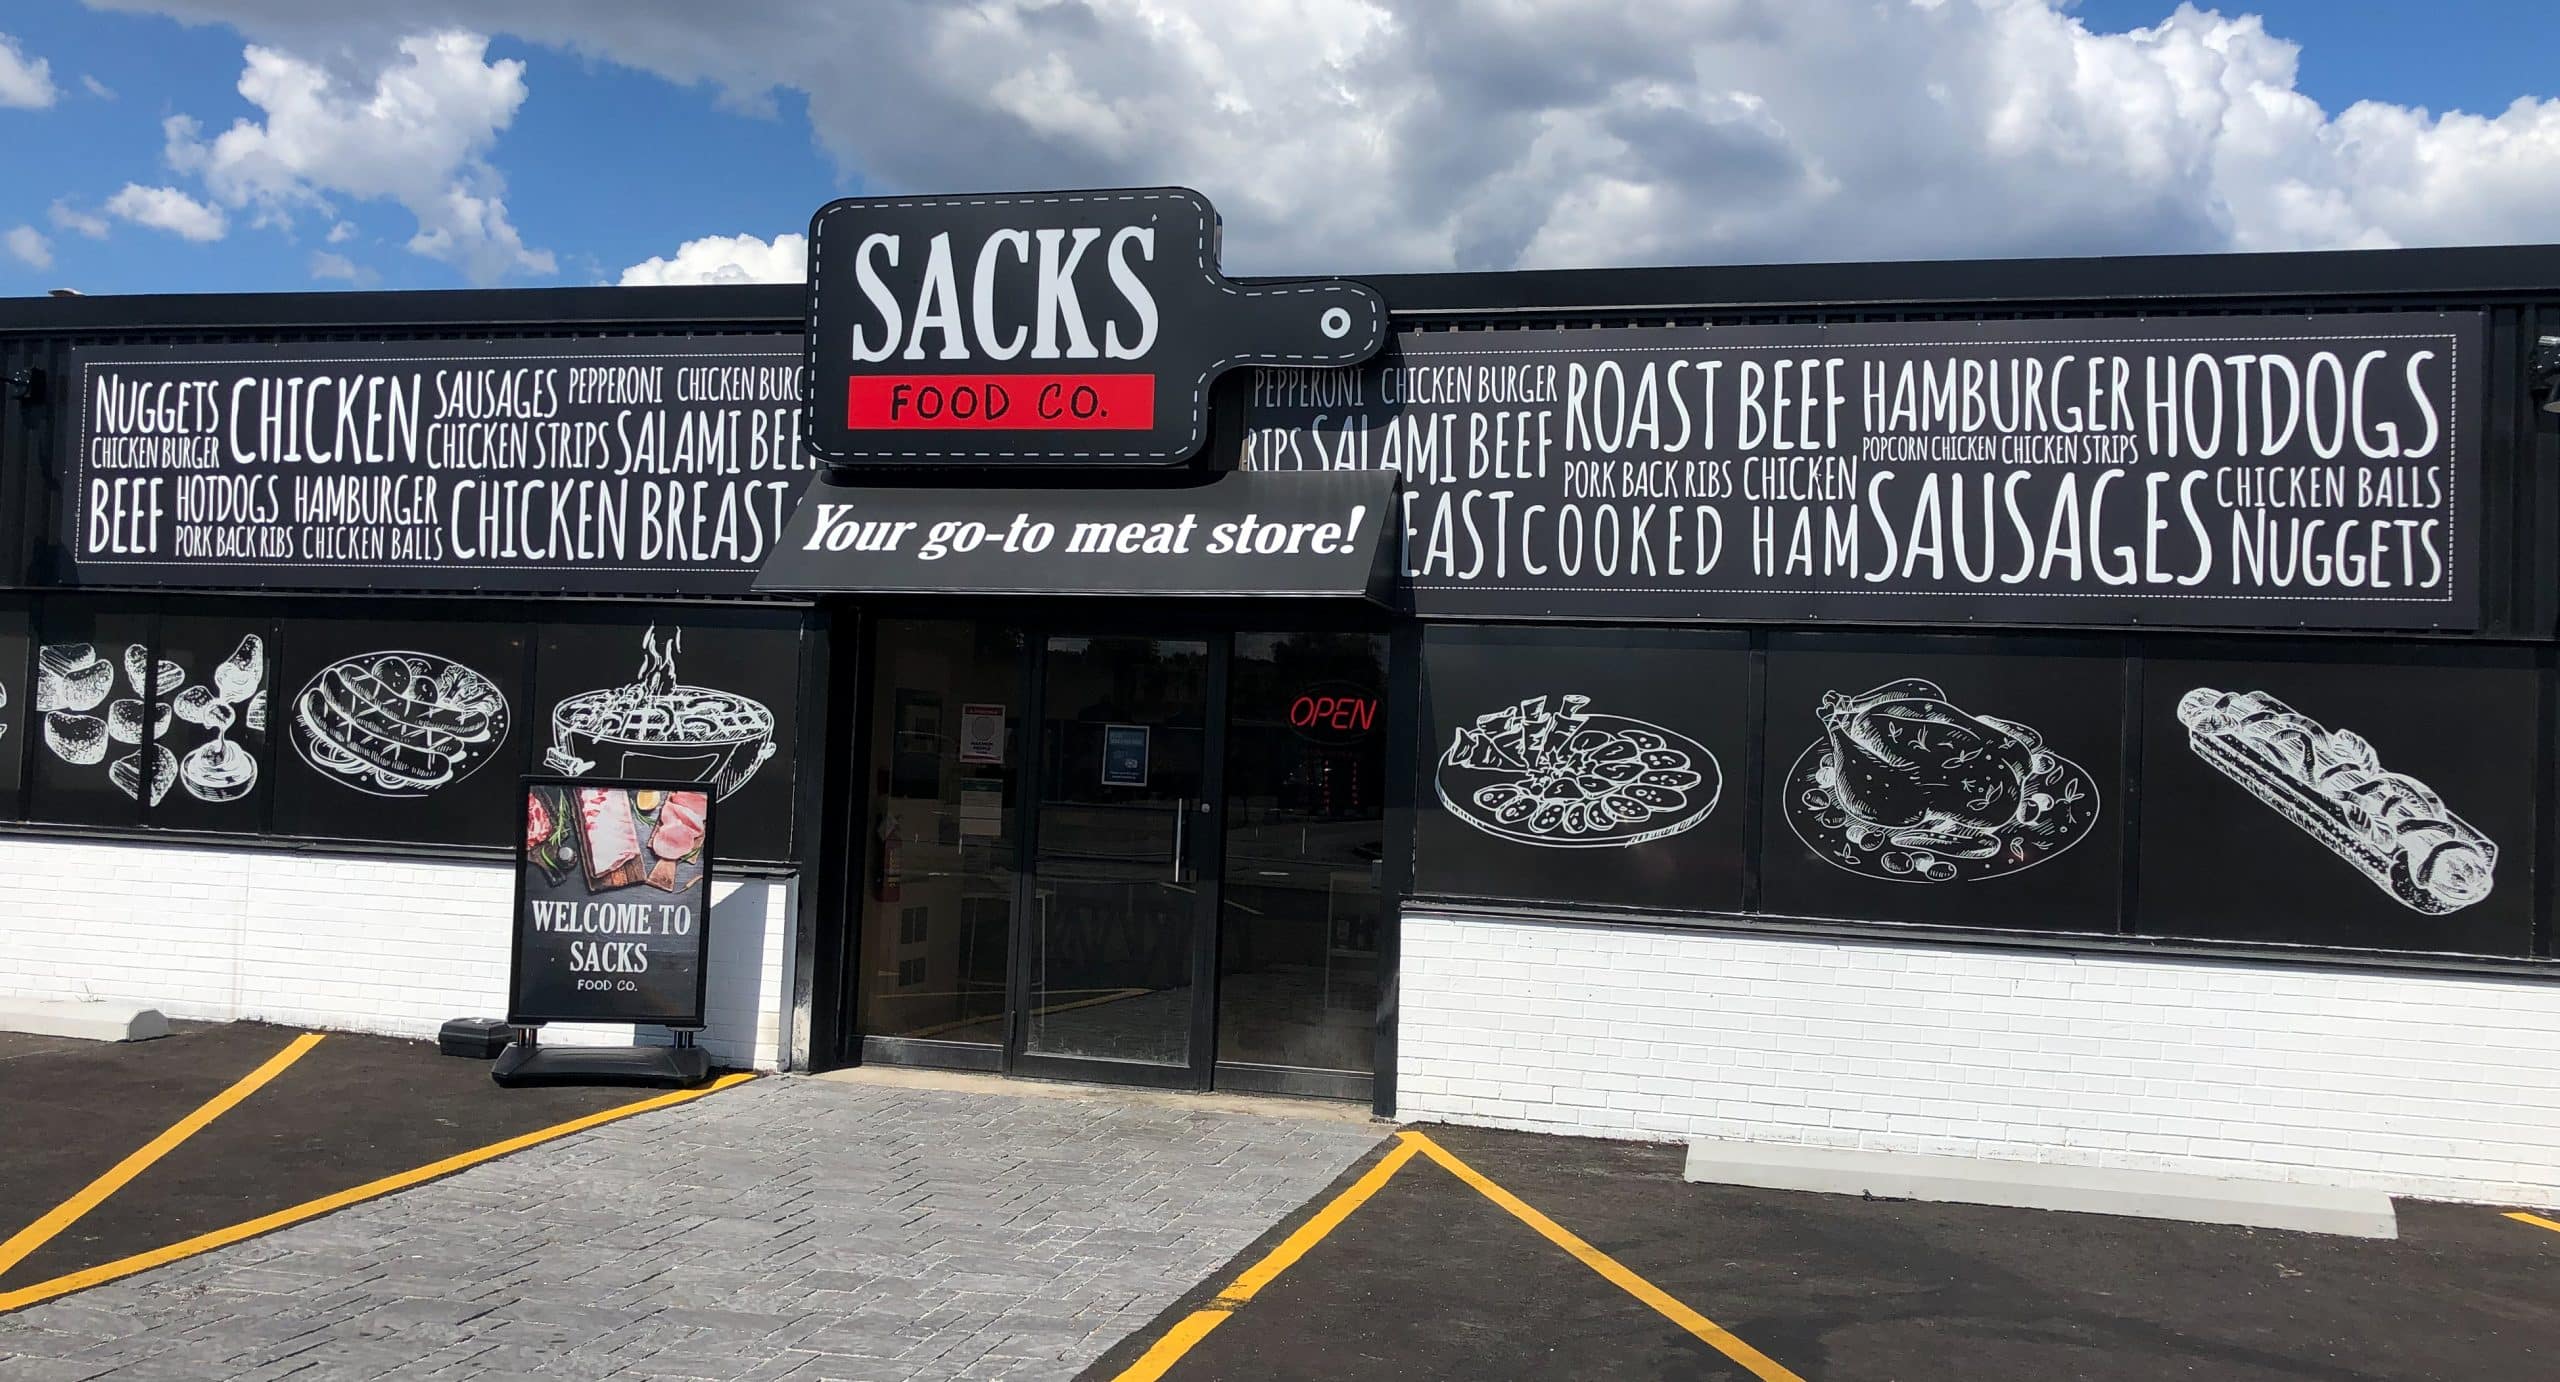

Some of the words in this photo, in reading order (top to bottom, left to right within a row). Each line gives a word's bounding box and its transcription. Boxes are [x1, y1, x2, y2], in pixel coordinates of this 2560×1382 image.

[853, 226, 1158, 362] SACKS
[96, 374, 219, 434] NUGGETS
[434, 368, 557, 419] SAUSAGES
[569, 366, 663, 404] PEPPERONI
[677, 366, 755, 401] CHICKEN
[760, 366, 803, 401] BURG
[892, 384, 1009, 420] FOOD
[1038, 383, 1107, 419] CO.
[1255, 368, 1364, 408] PEPPERONI
[1382, 365, 1472, 404] CHICKEN
[1478, 365, 1557, 403] BURGER
[1566, 360, 1722, 453] ROAST
[1739, 358, 1845, 450] BEEF
[1864, 356, 2134, 433] HAMBURGER
[2147, 350, 2438, 459] HOTDOGS
[230, 374, 421, 464] CHICKEN
[614, 409, 741, 476] SALAMI
[750, 407, 816, 470] BEE
[92, 436, 158, 469] CHICKEN
[162, 436, 219, 469] BURGER
[427, 422, 528, 469] CHICKEN
[533, 422, 609, 469] STRIPS
[1247, 428, 1303, 471] RIPS
[1469, 411, 1552, 478] BEEF
[1863, 436, 1928, 461] POPCORN
[1932, 436, 1996, 461] CHICKEN
[2002, 435, 2077, 464] CHICKEN
[2082, 435, 2138, 464] STRIPS
[177, 474, 278, 523] HOTDOGS
[295, 475, 438, 525] HAMBURGER
[1565, 460, 1615, 498] PORK
[1623, 460, 1678, 498] BACK
[1685, 460, 1732, 498] RIBS
[1744, 455, 1857, 501] CHICKEN
[2217, 466, 2345, 508] CHICKEN
[2358, 466, 2441, 508] BALLS
[89, 478, 163, 553] BEEF
[452, 478, 628, 560] CHICKEN
[641, 480, 788, 562] BREAST
[803, 504, 917, 551] Your
[918, 514, 1054, 560] go-to
[1065, 514, 1197, 553] meat
[1206, 505, 1365, 554] store!
[1401, 490, 1514, 579] EAST
[1864, 469, 2212, 585] SAUSAGES
[176, 525, 212, 557] PORK
[216, 526, 256, 557] BACK
[260, 526, 293, 558] RIBS
[303, 526, 384, 560] CHICKEN
[391, 527, 442, 560] BALLS
[1523, 504, 1722, 576] COOKED
[1753, 504, 1857, 578] HAM
[2233, 508, 2441, 588] NUGGETS
[1291, 697, 1376, 730] OPEN
[532, 901, 652, 934] WELCOME
[659, 905, 691, 935] TO
[570, 941, 647, 973] SACKS
[578, 979, 612, 990] FOOD
[617, 980, 638, 992] CO.
